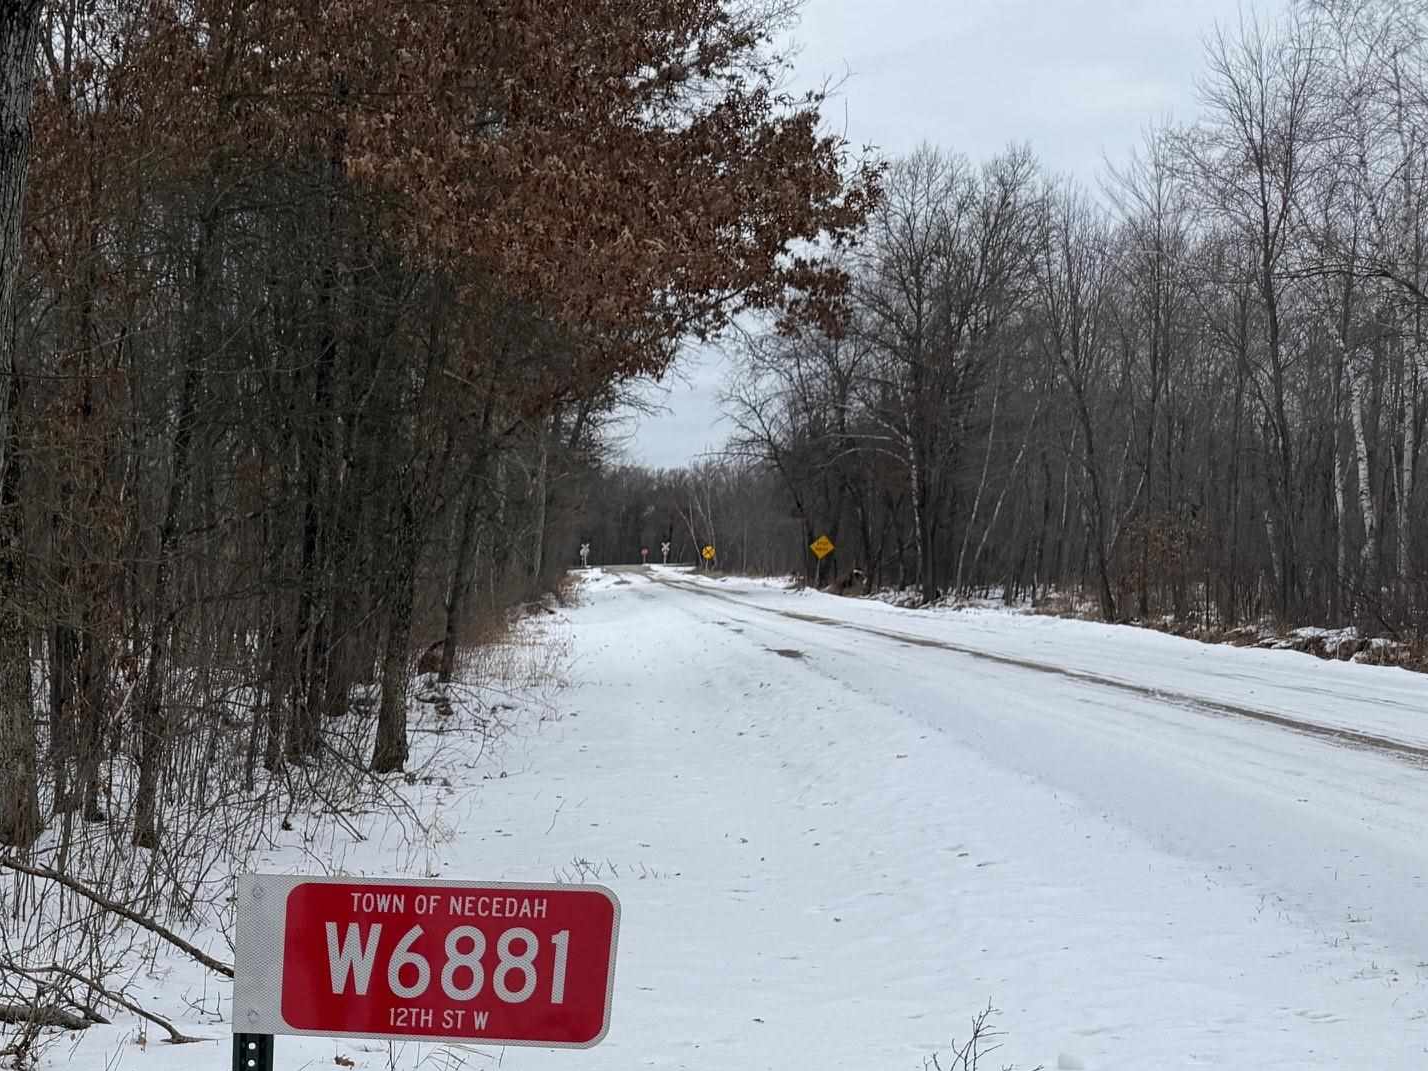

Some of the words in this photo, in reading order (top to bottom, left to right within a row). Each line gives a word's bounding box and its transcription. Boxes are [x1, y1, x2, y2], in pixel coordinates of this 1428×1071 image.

[350, 892, 405, 913] TOWN
[414, 895, 442, 914] OF
[449, 896, 548, 918] NECEDAH
[325, 921, 570, 1004] W6881
[389, 1007, 433, 1028] 12TH
[442, 1009, 466, 1029] ST
[473, 1010, 489, 1030] W
